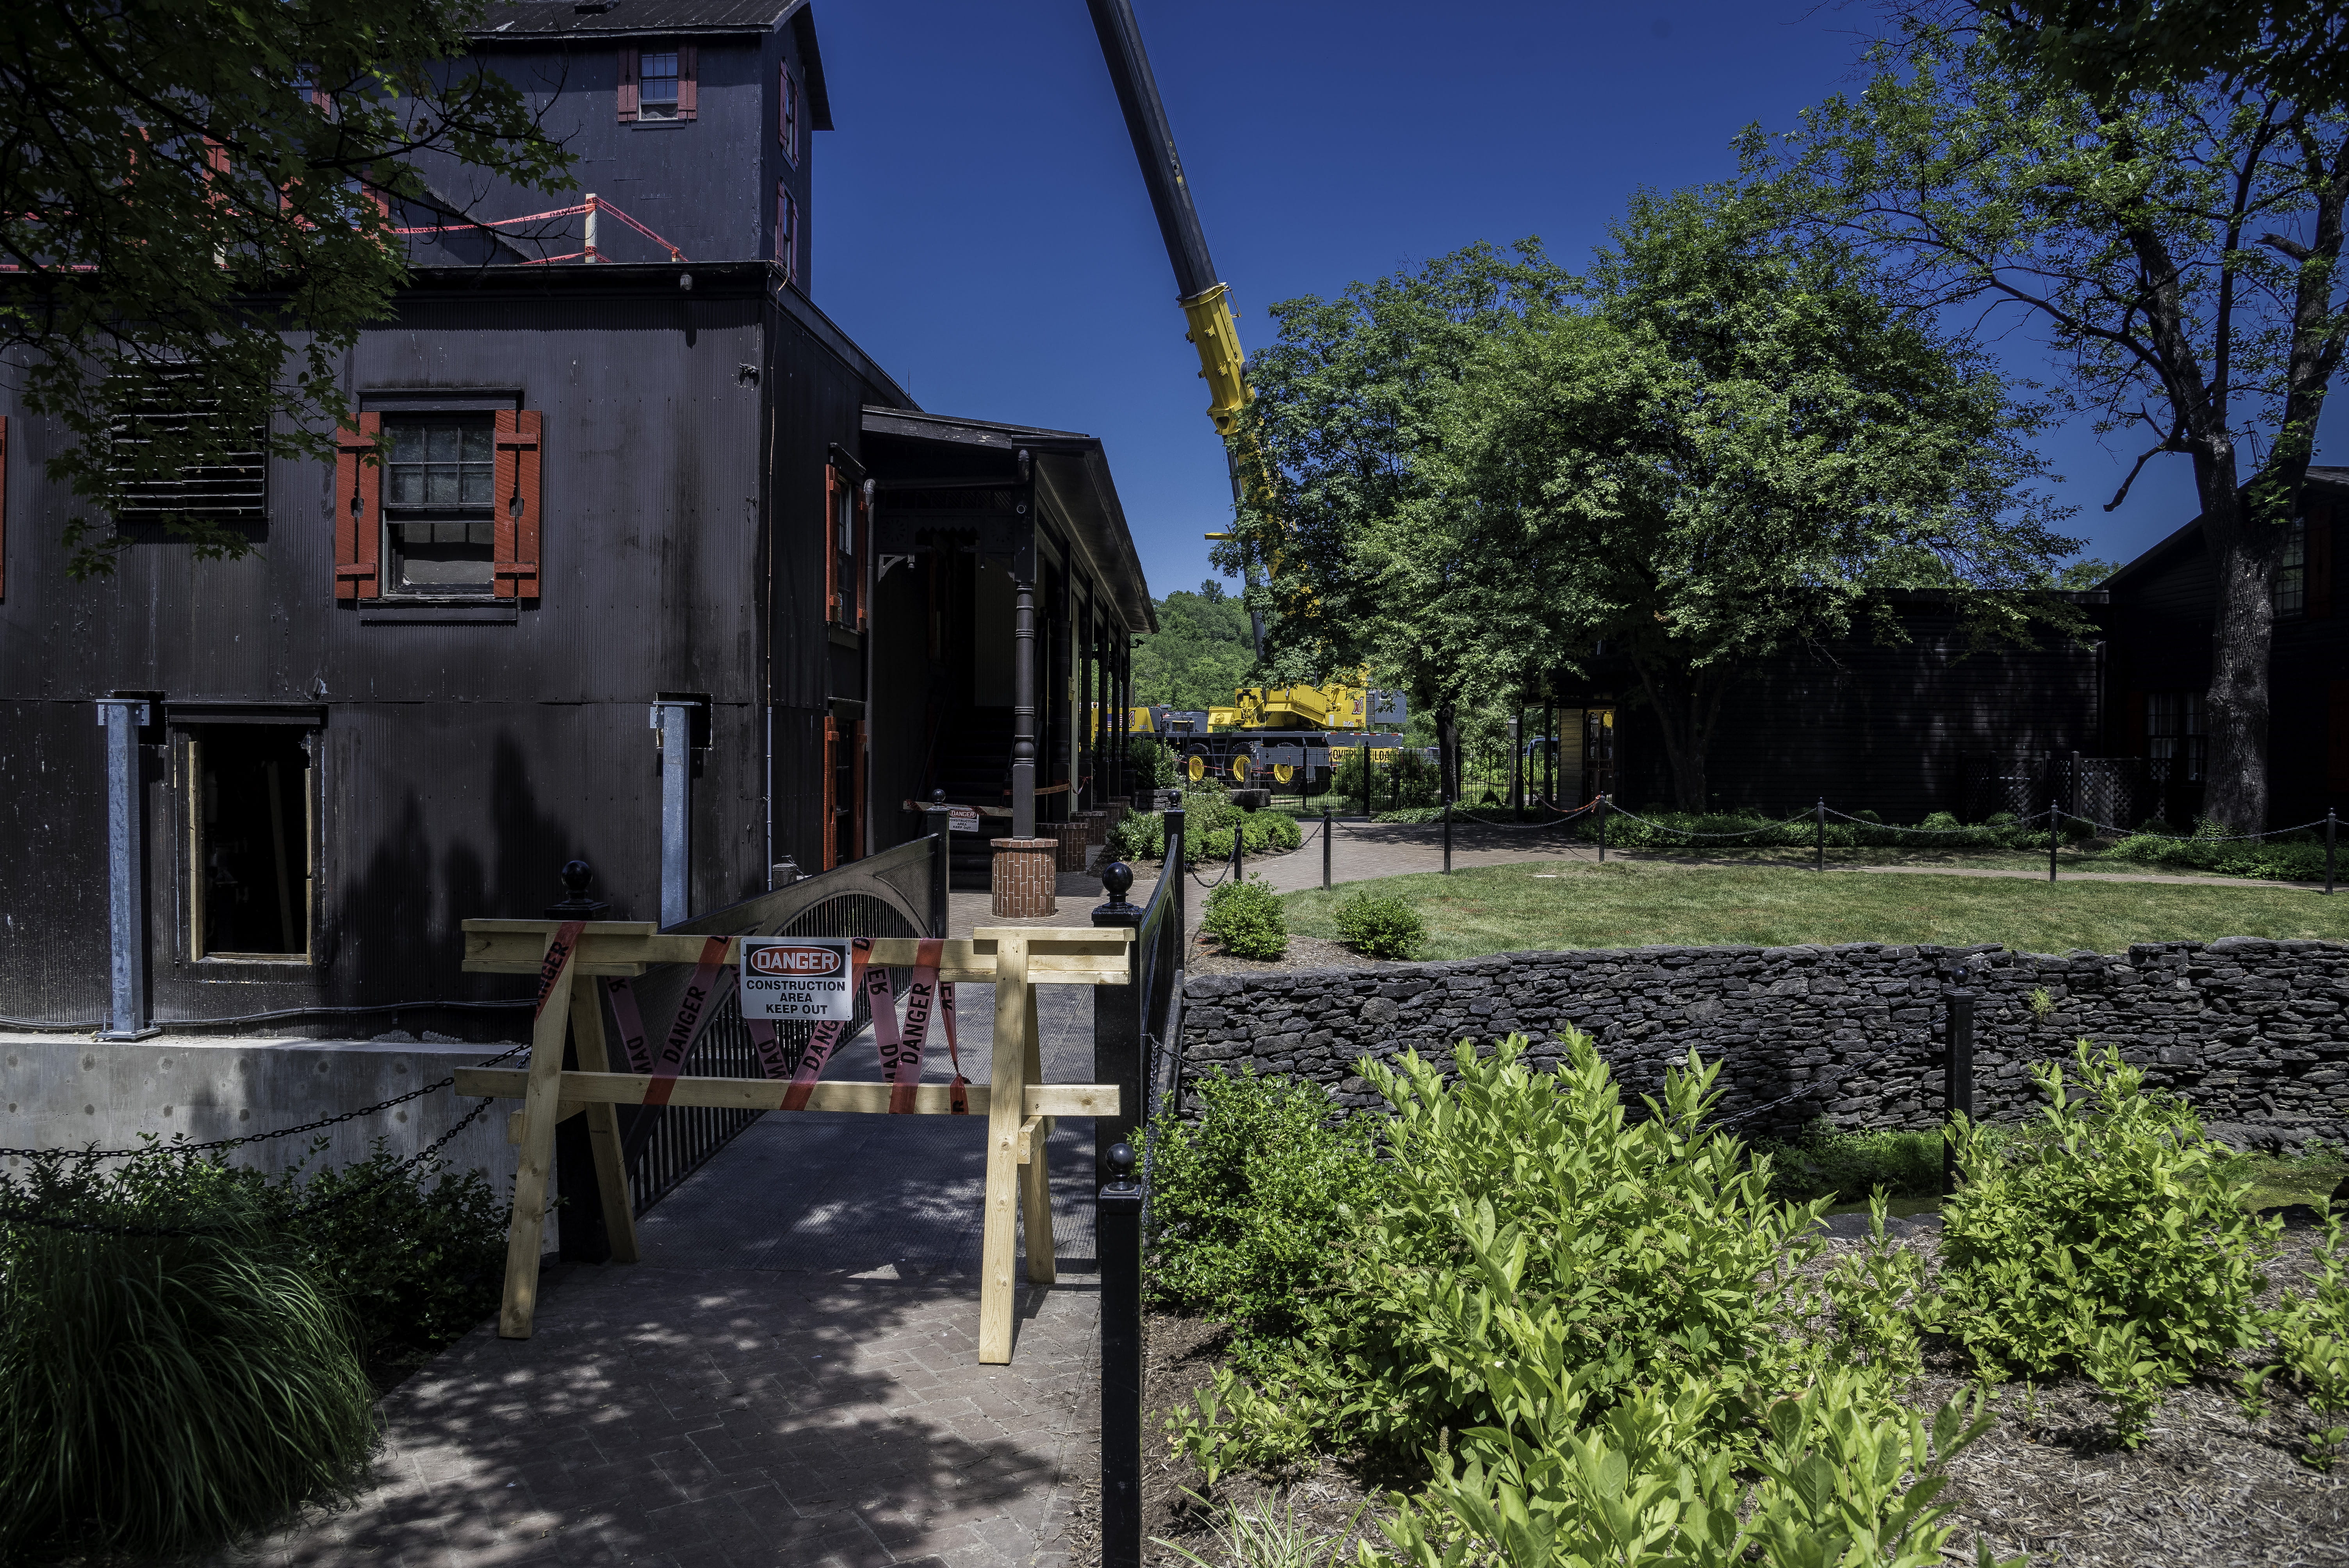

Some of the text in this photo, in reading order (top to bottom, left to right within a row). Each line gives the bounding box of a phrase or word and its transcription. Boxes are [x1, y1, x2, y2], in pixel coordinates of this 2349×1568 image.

[757, 952, 834, 969] DANGER
[746, 980, 846, 991] CONSTRUCTION
[780, 992, 813, 1003] AREA
[766, 1004, 828, 1015] KEEP OUT
[662, 985, 706, 1064] DANGER
[900, 982, 932, 1065] DANGER
[802, 1020, 840, 1072] DANG
